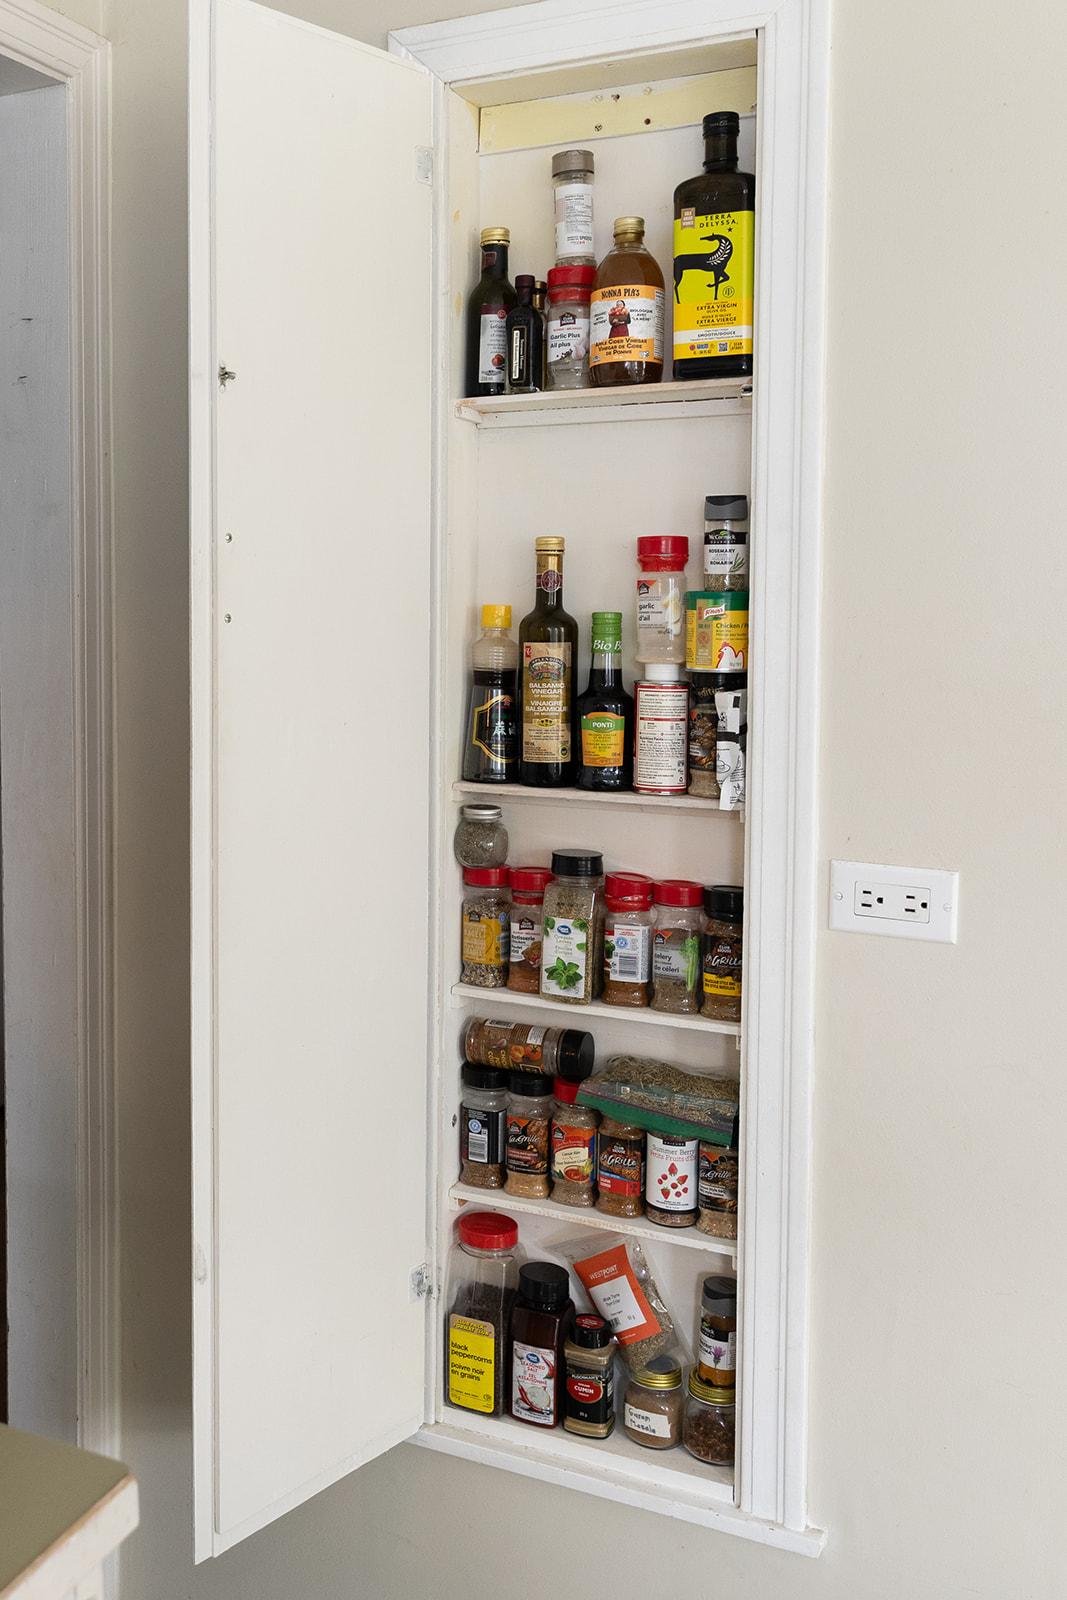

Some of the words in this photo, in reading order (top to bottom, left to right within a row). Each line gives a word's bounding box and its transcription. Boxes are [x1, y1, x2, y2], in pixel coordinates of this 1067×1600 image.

[602, 289, 621, 299] NONNA
[593, 640, 611, 650] Bio
[652, 1144, 677, 1155] Summer
[589, 1264, 617, 1280] WESTPOINT
[451, 1341, 468, 1351] black
[451, 1349, 492, 1365] peppercorns
[451, 1362, 470, 1372] poivre
[472, 1368, 485, 1376] noir
[521, 1360, 545, 1370] SEASONED
[460, 1372, 480, 1381] grains
[574, 1385, 594, 1394] CUMIN
